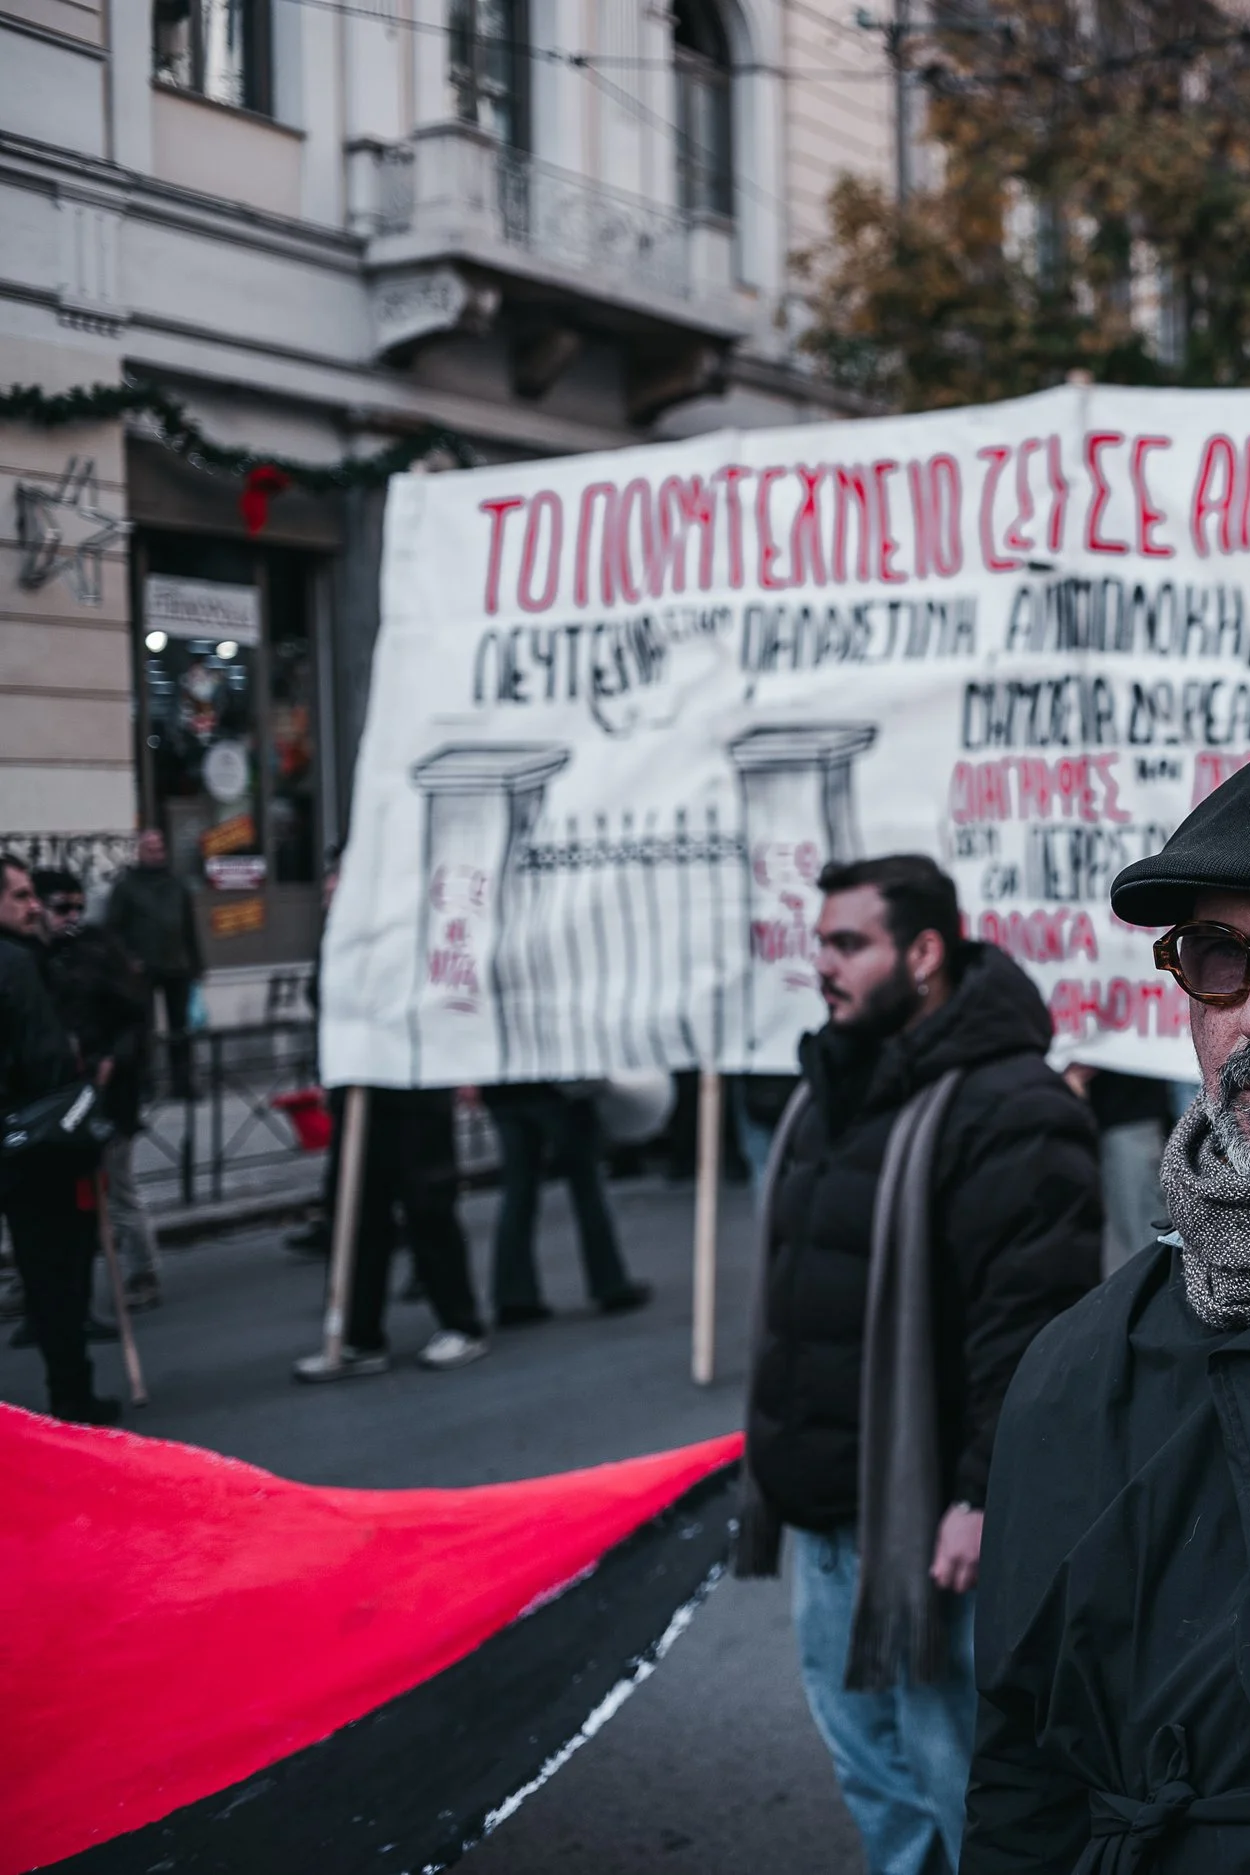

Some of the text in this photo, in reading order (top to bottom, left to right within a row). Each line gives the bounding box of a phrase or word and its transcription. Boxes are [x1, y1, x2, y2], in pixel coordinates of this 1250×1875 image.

[480, 492, 562, 615] ΤΟ
[574, 452, 963, 608] ΠΟΛΥΤΕΧΝΕΙΟ
[1084, 430, 1176, 558] ΣΕ
